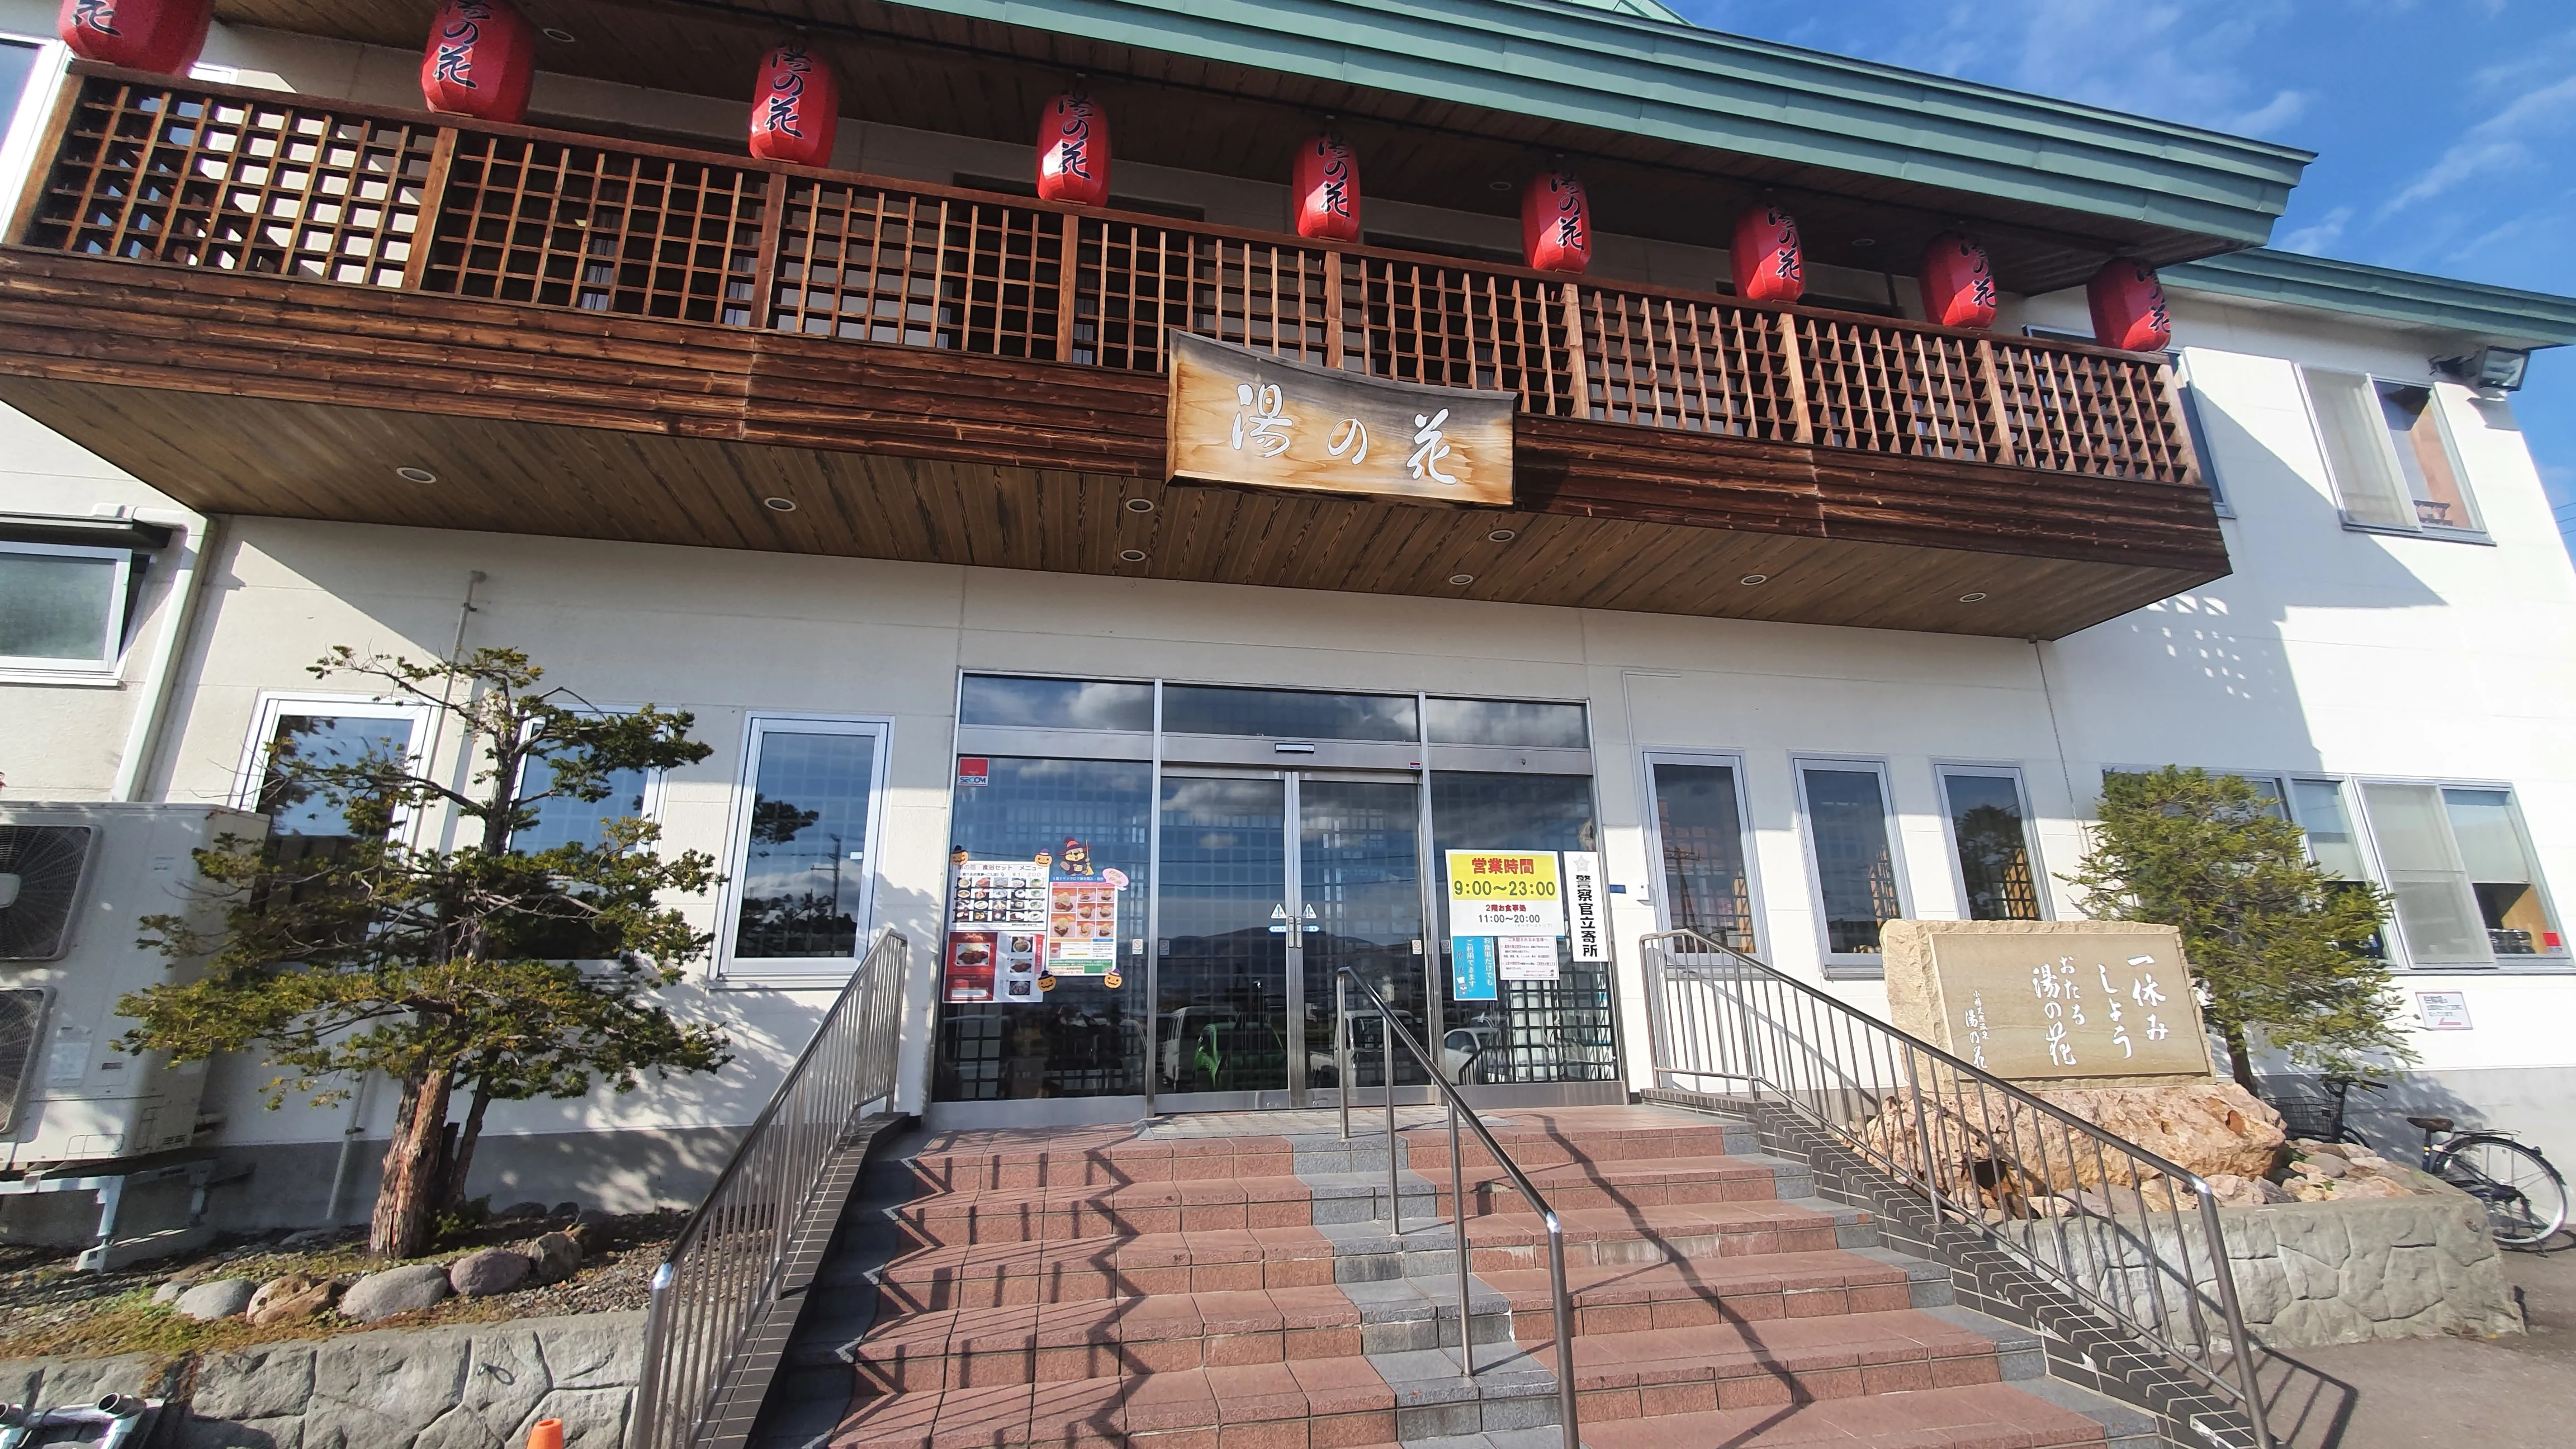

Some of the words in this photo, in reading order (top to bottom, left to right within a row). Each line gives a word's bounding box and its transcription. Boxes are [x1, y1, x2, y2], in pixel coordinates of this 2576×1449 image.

[1232, 383, 1457, 485] 湯の花
[1471, 858, 1535, 875] 営業時間
[1575, 874, 1598, 958] 警察官立寄所
[1466, 939, 1476, 988] ご利用できます
[1483, 937, 1493, 986] お食事だけでも
[2059, 955, 2086, 1026] おたる
[2127, 954, 2169, 1040] 一休み
[2032, 963, 2077, 1067] 湯の花
